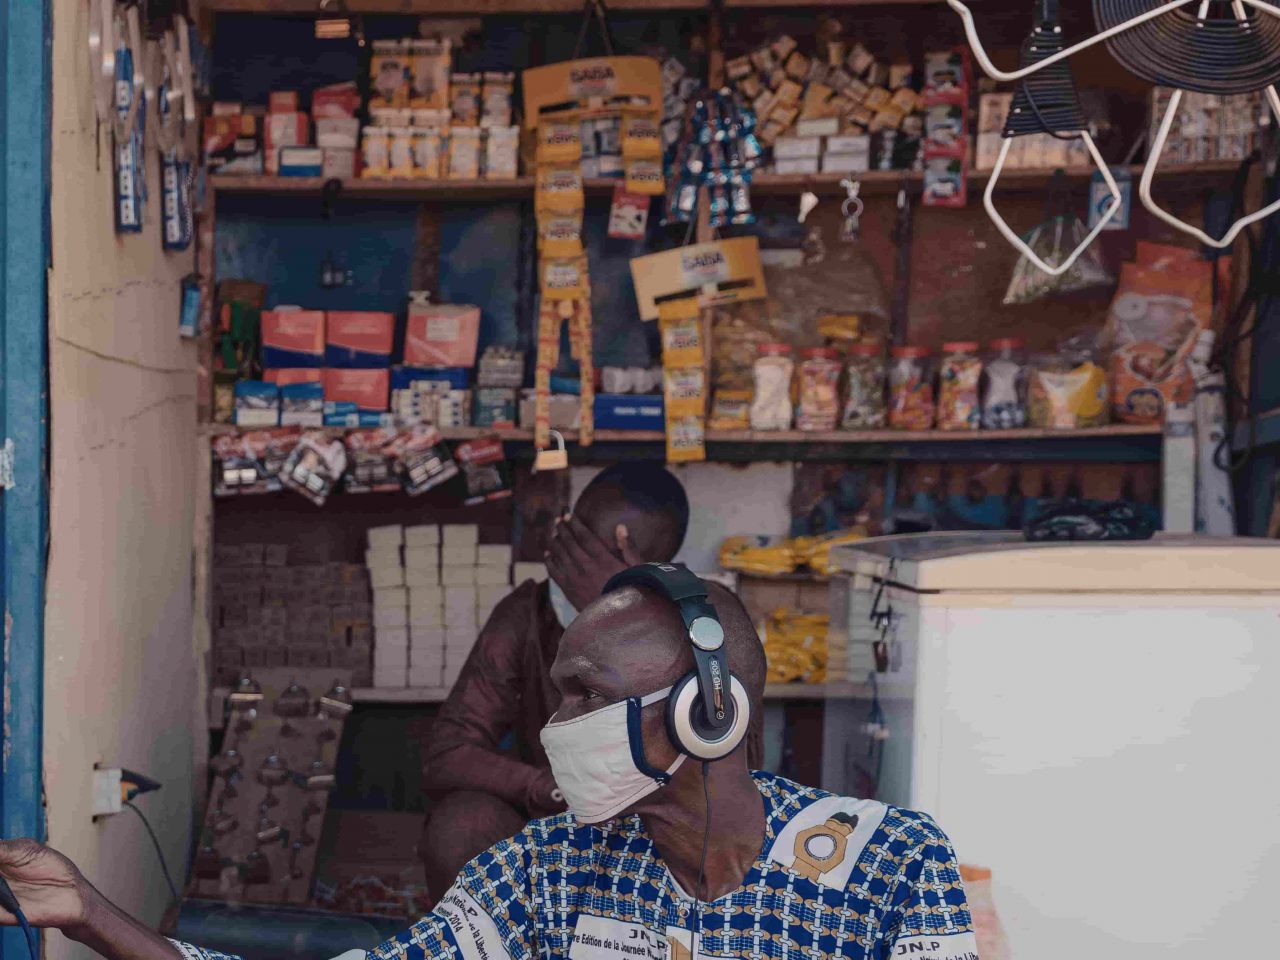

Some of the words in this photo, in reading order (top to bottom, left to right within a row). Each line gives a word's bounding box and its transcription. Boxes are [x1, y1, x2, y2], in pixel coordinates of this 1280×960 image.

[712, 660, 721, 675] 205
[713, 676, 722, 690] HD
[581, 933, 602, 948] Edition
[603, 939, 612, 950] de
[613, 940, 619, 950] la
